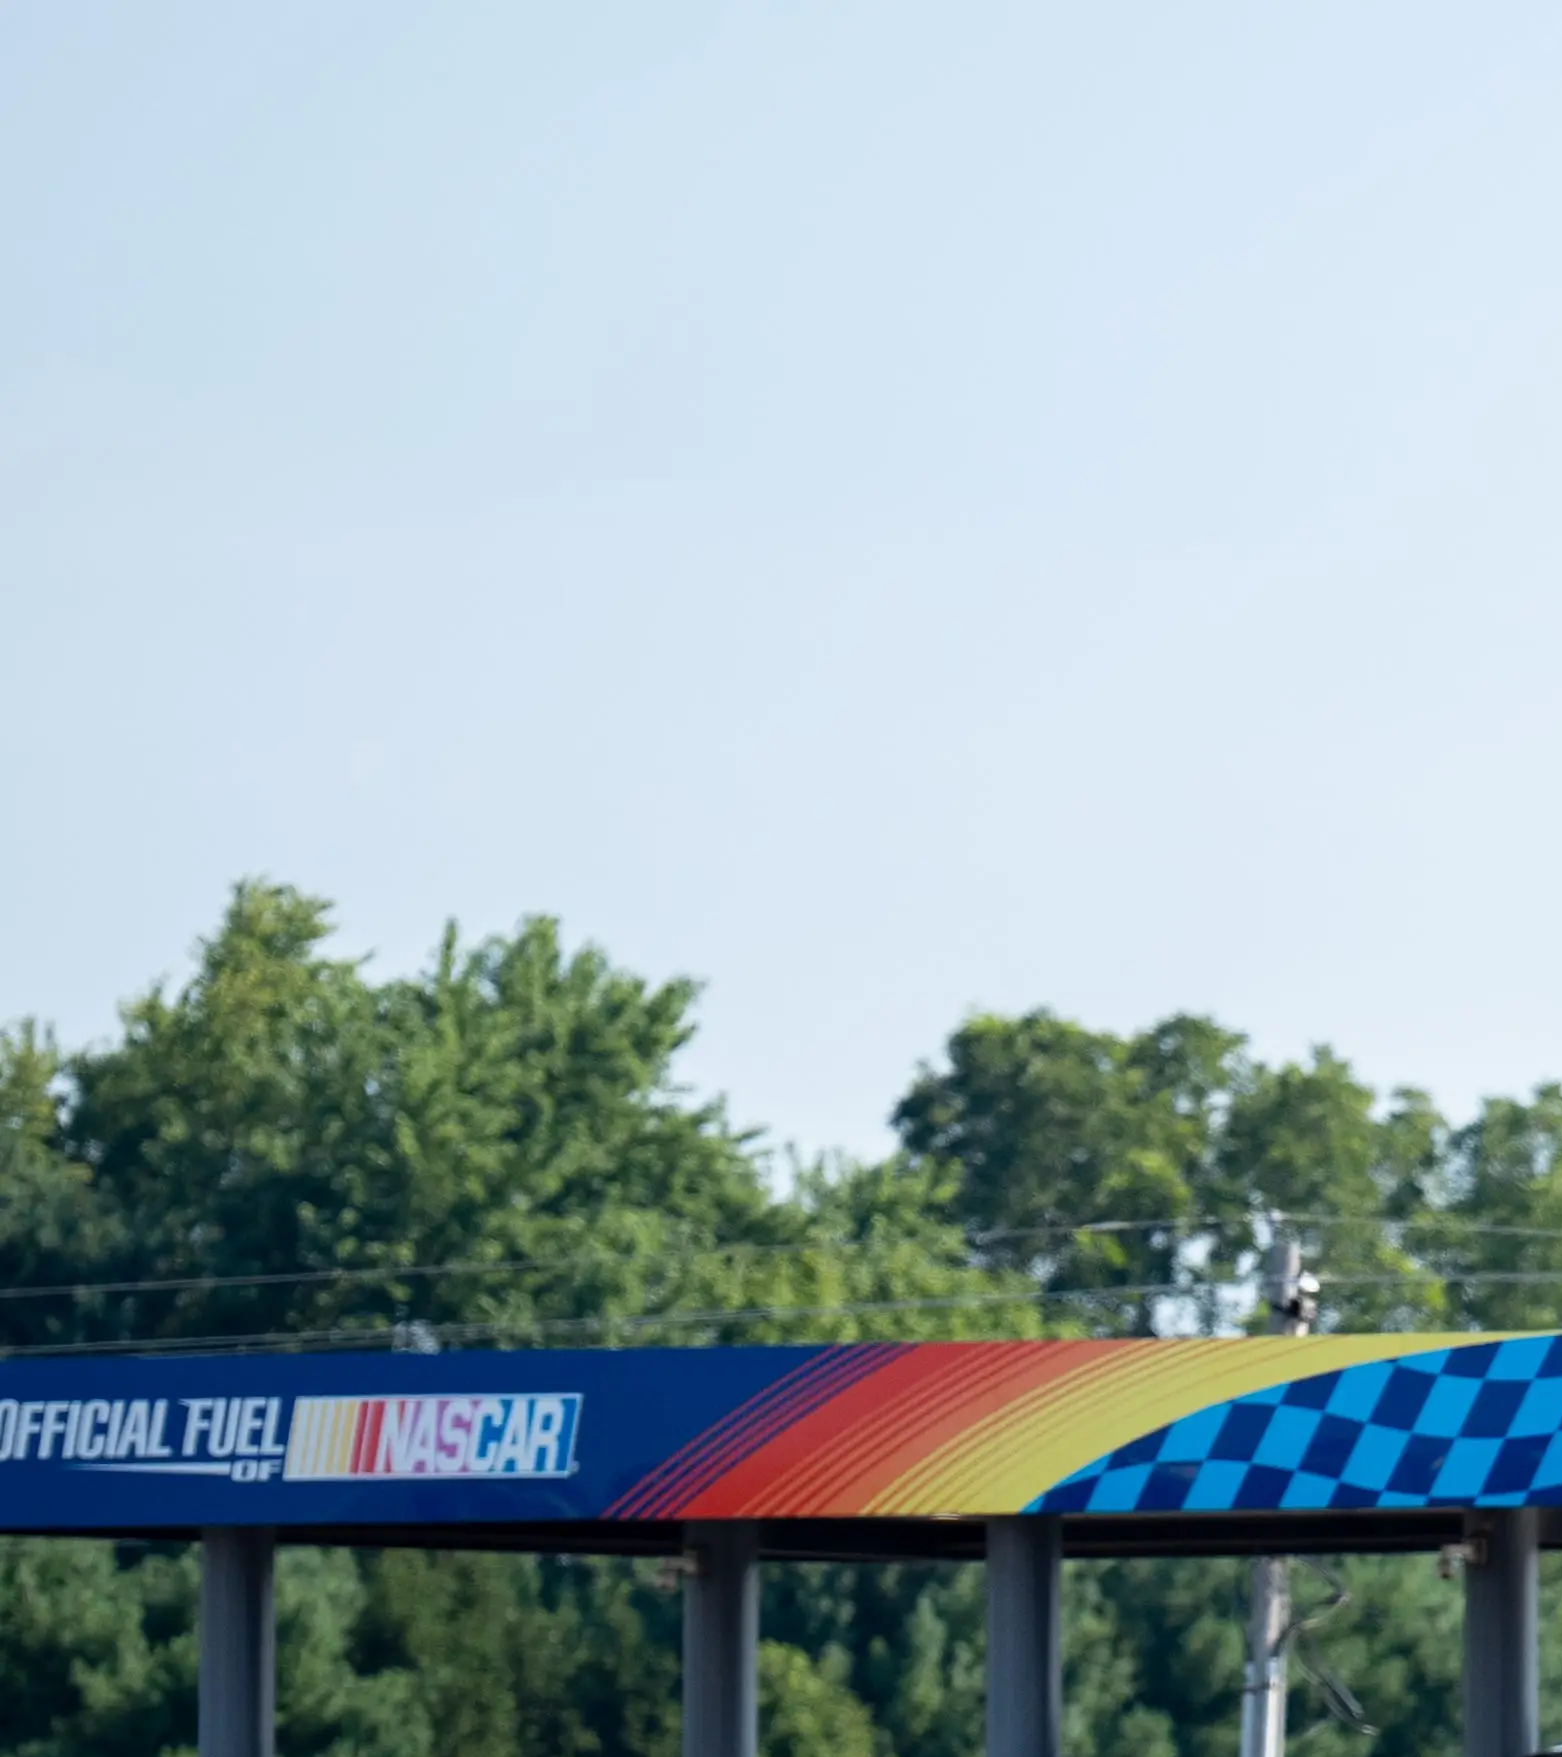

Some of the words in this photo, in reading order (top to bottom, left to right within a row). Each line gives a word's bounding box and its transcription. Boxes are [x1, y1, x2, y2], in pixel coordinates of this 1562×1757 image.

[0, 1399, 173, 1462] OFFICIAL
[178, 1397, 286, 1456] FUEL
[230, 1459, 283, 1482] OF
[378, 1400, 566, 1475] NASCAR
